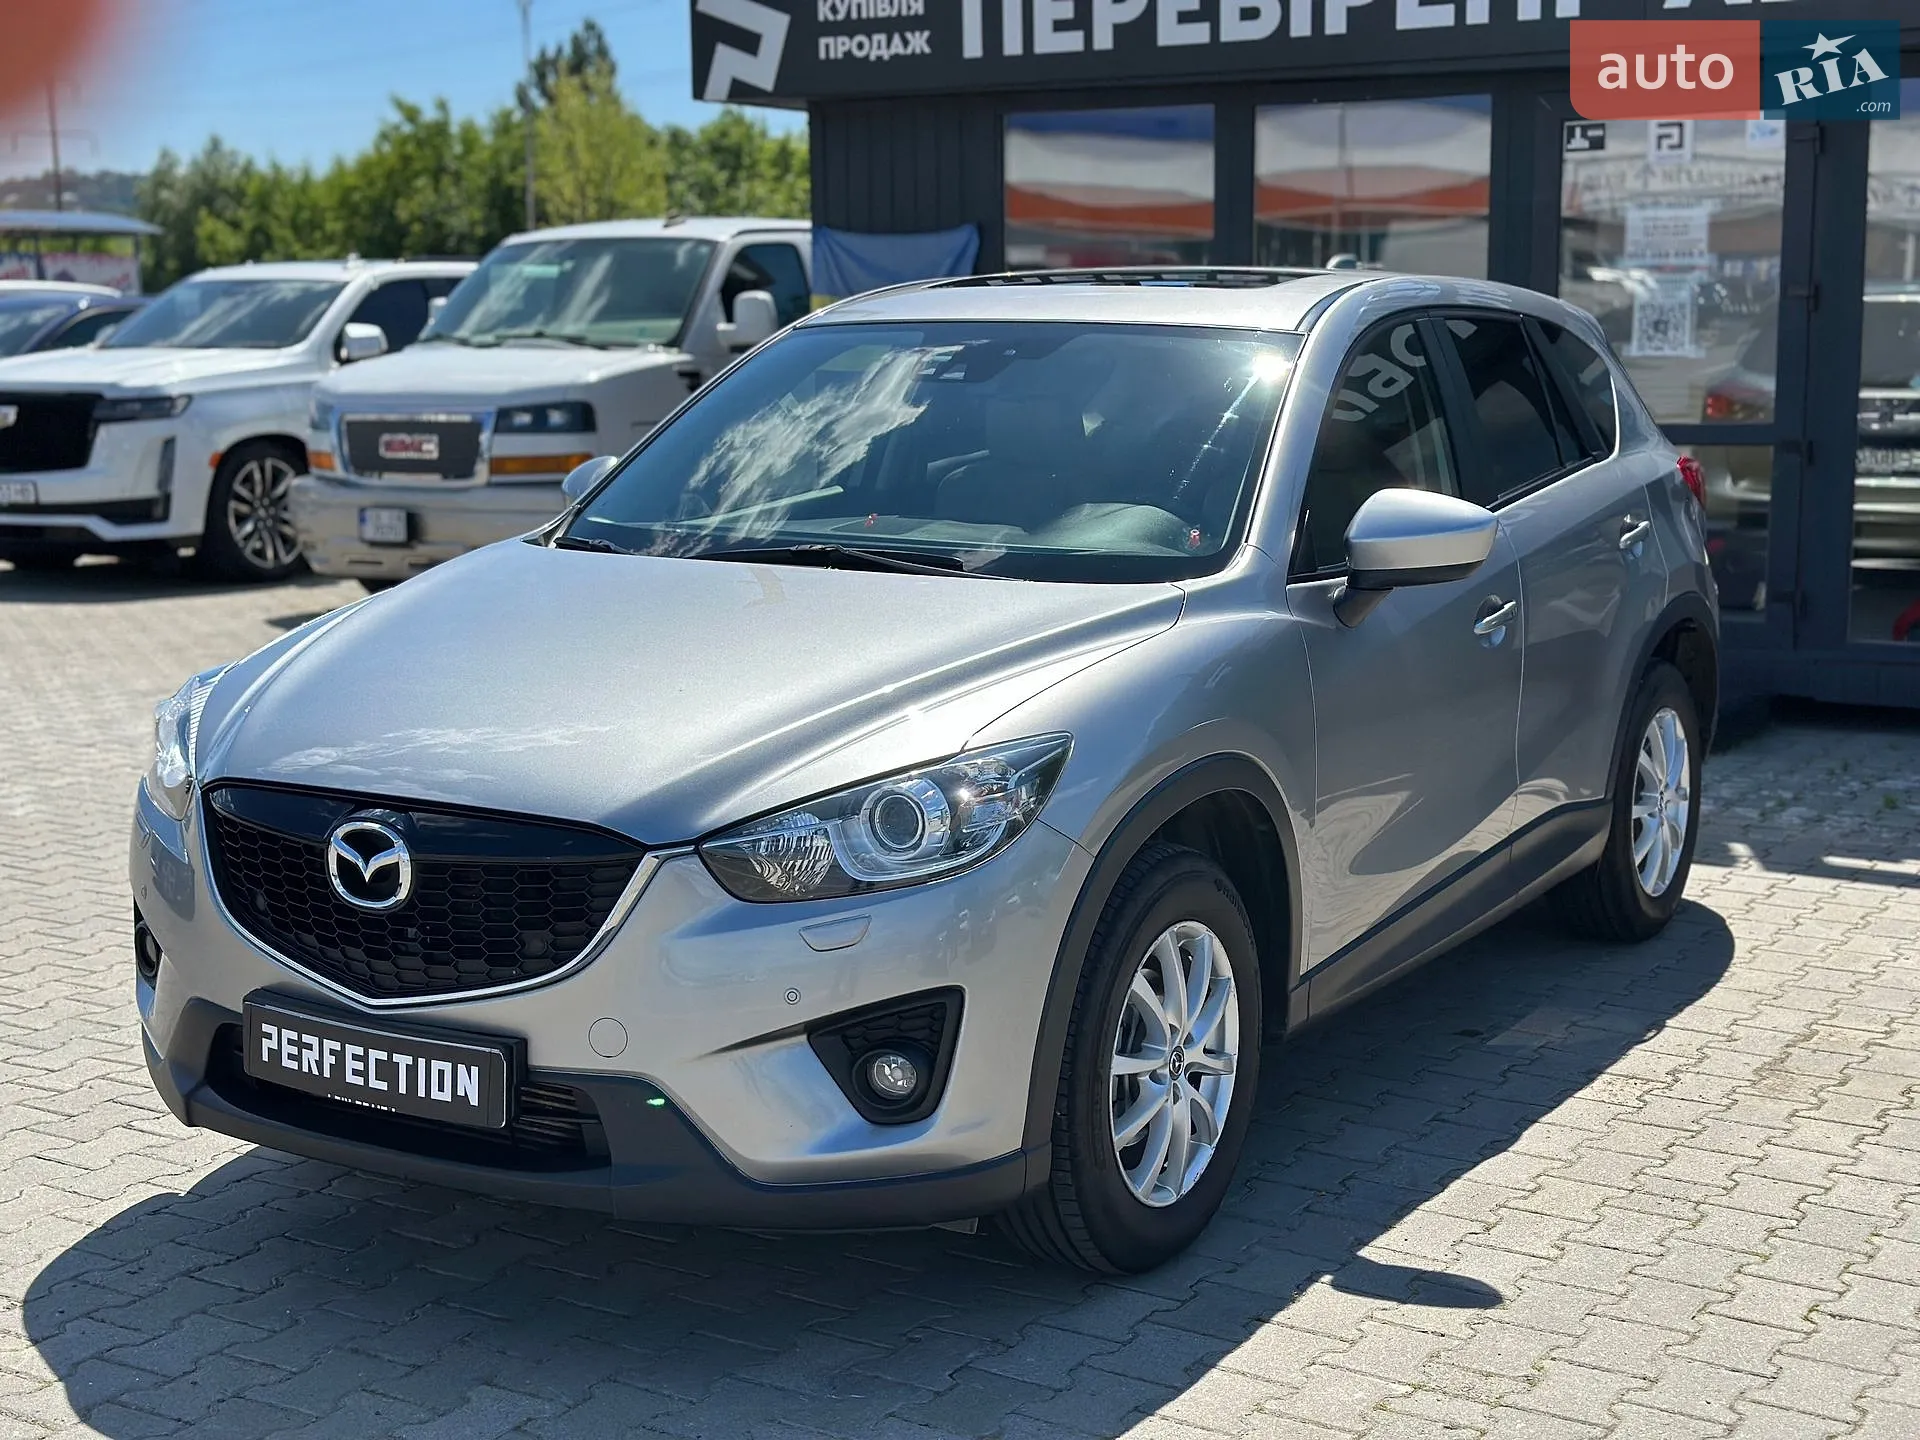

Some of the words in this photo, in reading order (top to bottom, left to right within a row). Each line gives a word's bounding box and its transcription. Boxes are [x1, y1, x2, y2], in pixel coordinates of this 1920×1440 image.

[817, 0, 925, 22] КУПІВЛЯ
[818, 30, 931, 61] ПРОДАЖ
[261, 1022, 479, 1107] PERFECTION
